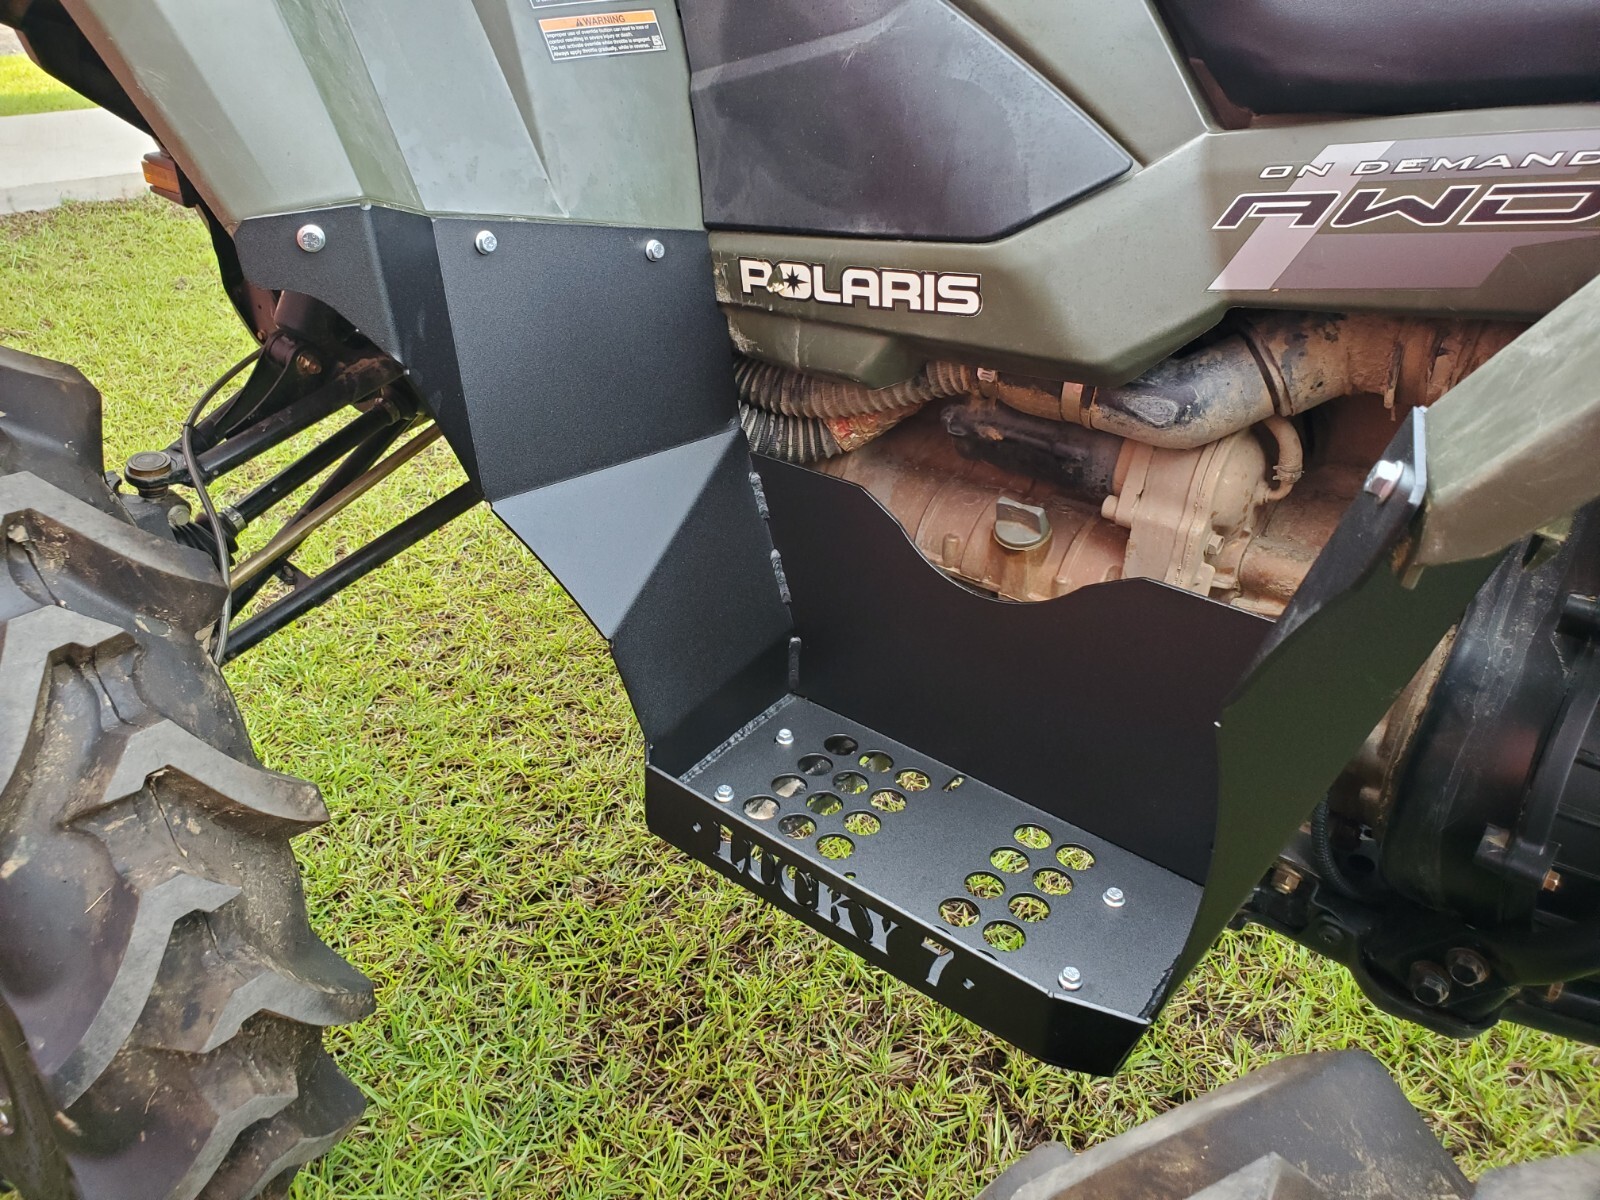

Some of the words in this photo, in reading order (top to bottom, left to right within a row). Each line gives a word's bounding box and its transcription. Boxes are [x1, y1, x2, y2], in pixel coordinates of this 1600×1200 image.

[583, 14, 626, 26] WARNING
[1259, 162, 1336, 180] ON
[1350, 150, 1600, 177] DEMAND
[1211, 180, 1600, 230] AWD
[738, 256, 983, 317] POLARIS
[711, 819, 903, 957] LUCKY
[920, 936, 955, 988] 7
